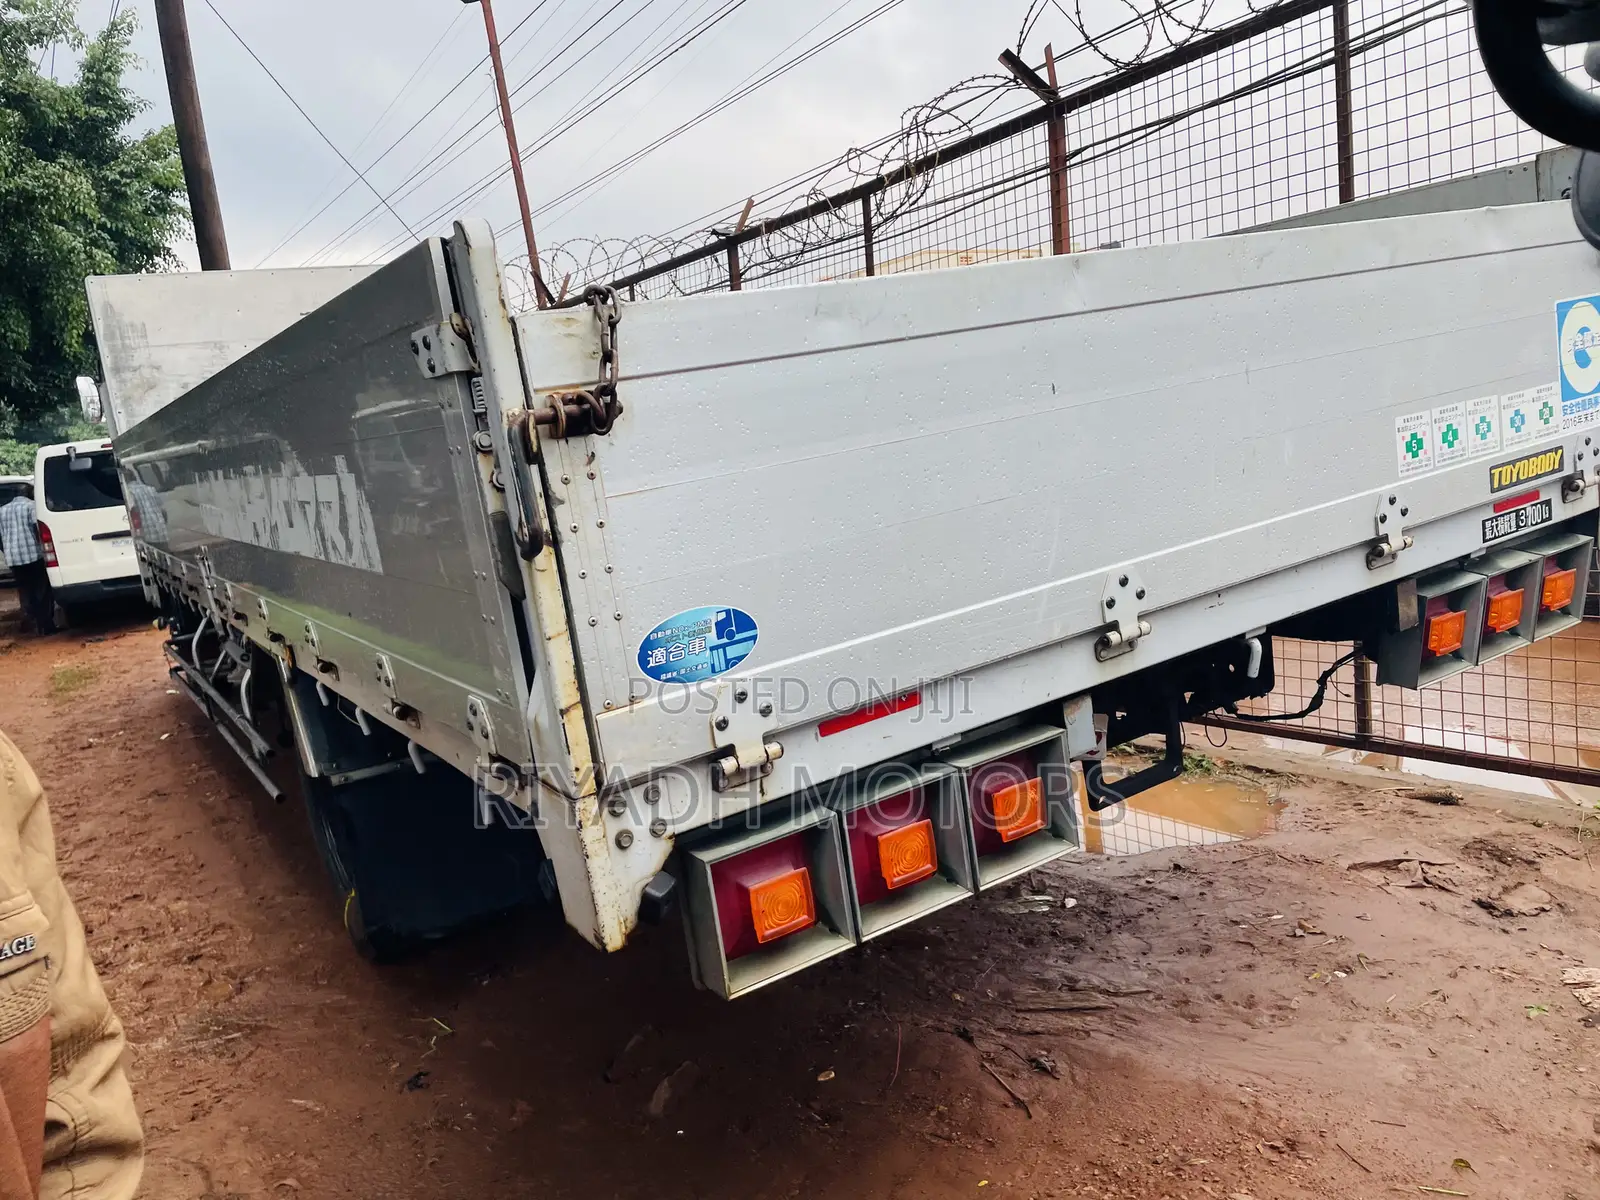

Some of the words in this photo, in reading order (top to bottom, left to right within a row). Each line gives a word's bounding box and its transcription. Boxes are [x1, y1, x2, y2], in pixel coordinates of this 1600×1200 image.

[1411, 440, 1418, 451] 5
[1447, 430, 1453, 442] 4
[1491, 449, 1562, 489] TOYOBODY
[646, 636, 707, 669] 適合車
